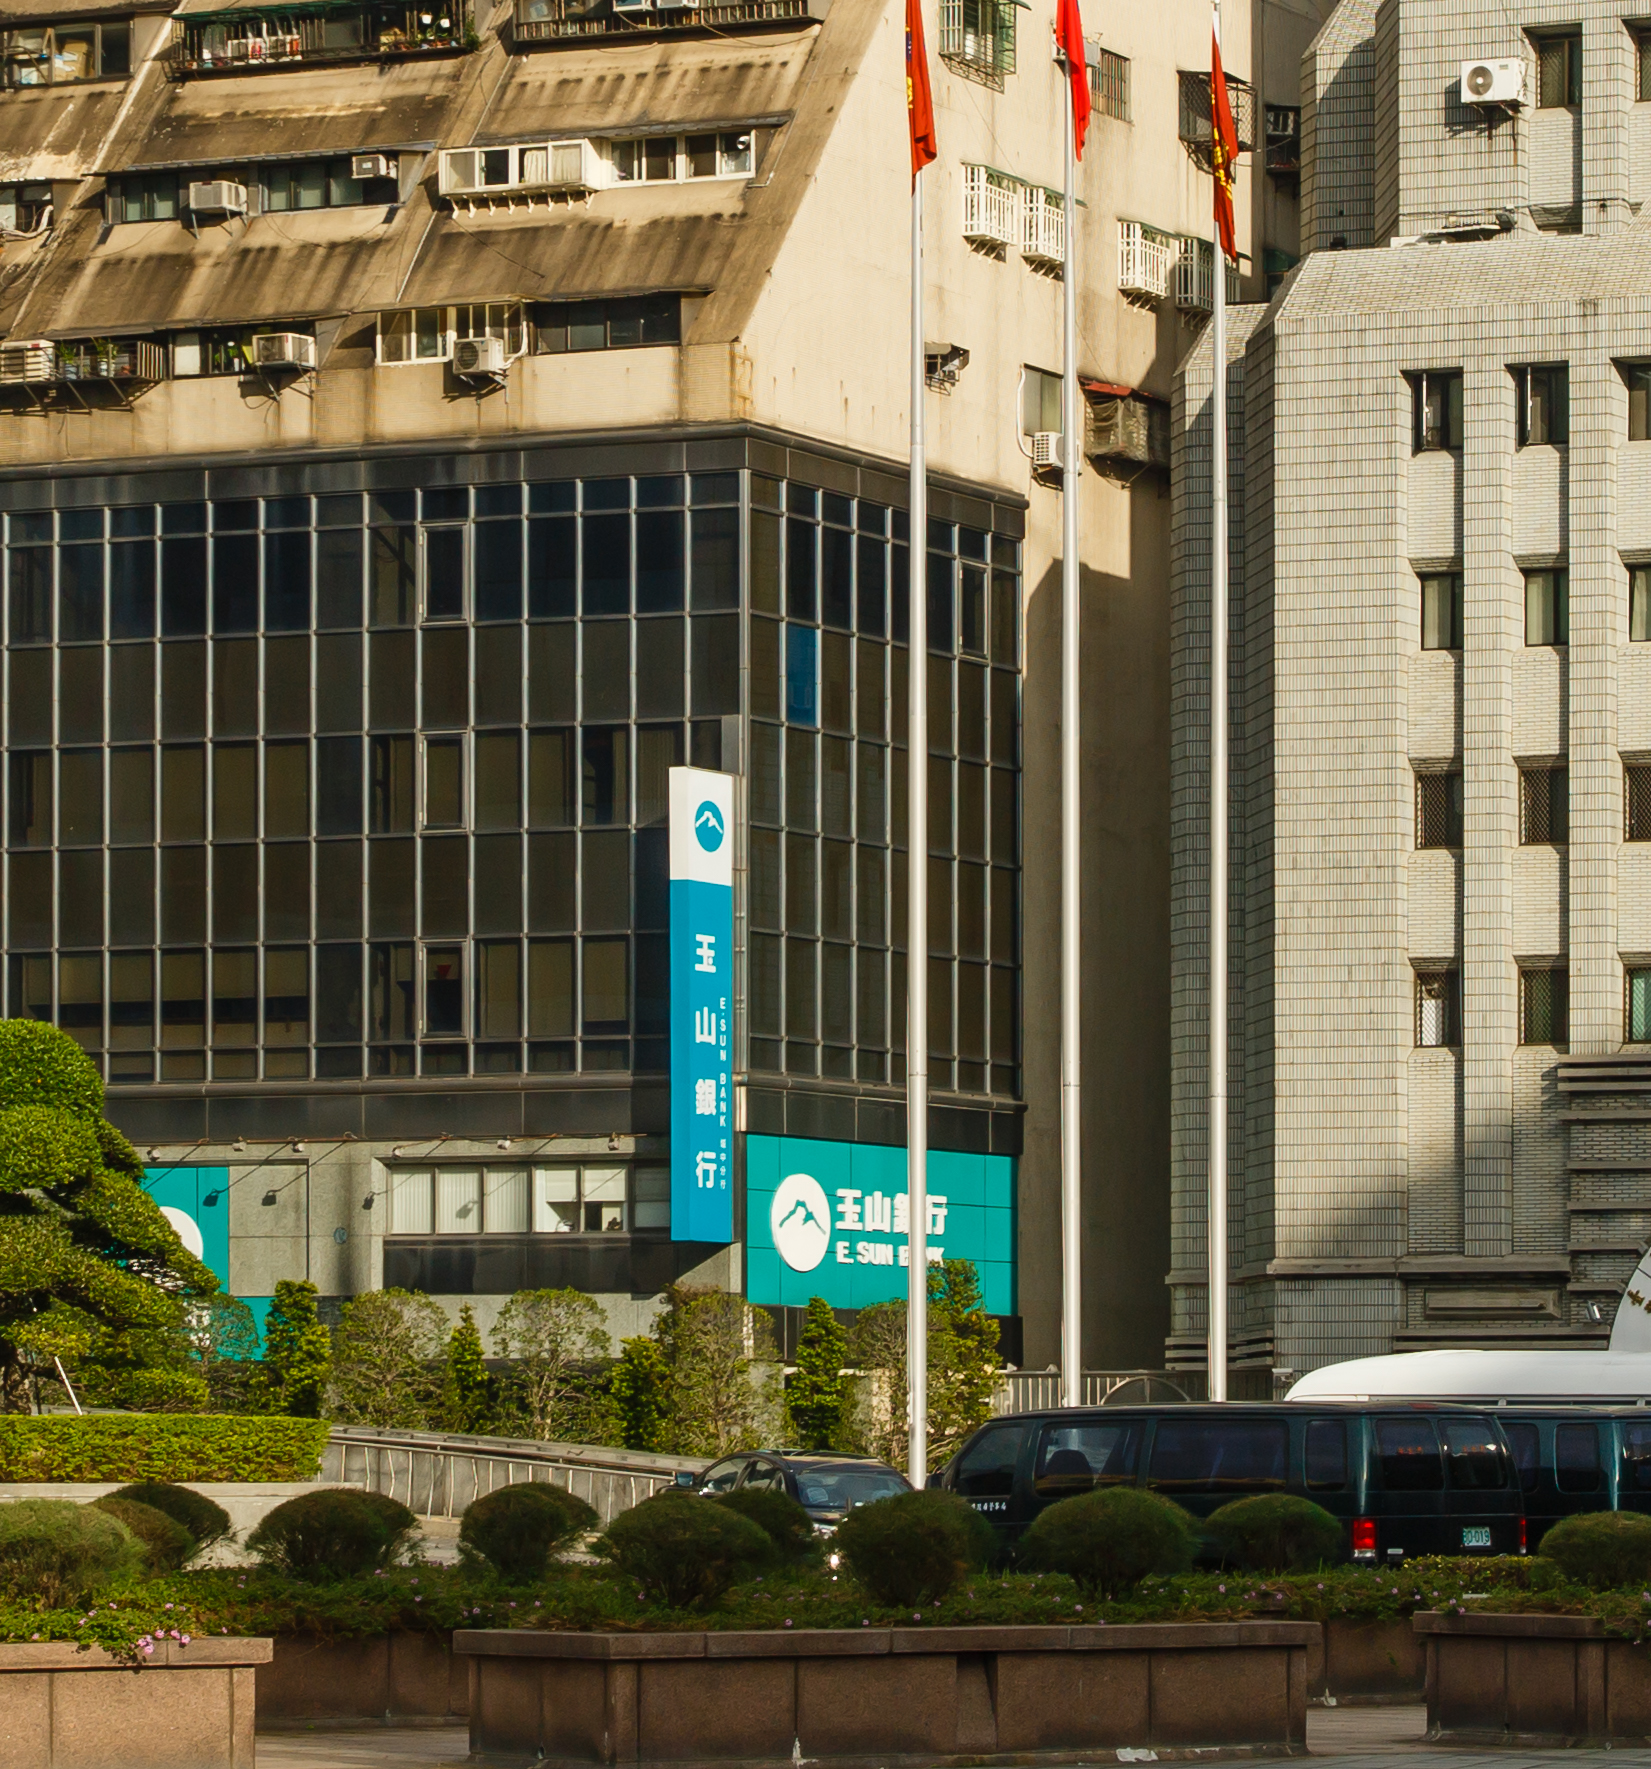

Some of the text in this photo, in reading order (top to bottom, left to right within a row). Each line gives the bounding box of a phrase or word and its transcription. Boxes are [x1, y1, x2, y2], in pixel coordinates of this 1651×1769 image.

[694, 933, 718, 1189] 玉山銀行
[719, 1072, 728, 1127] BANK
